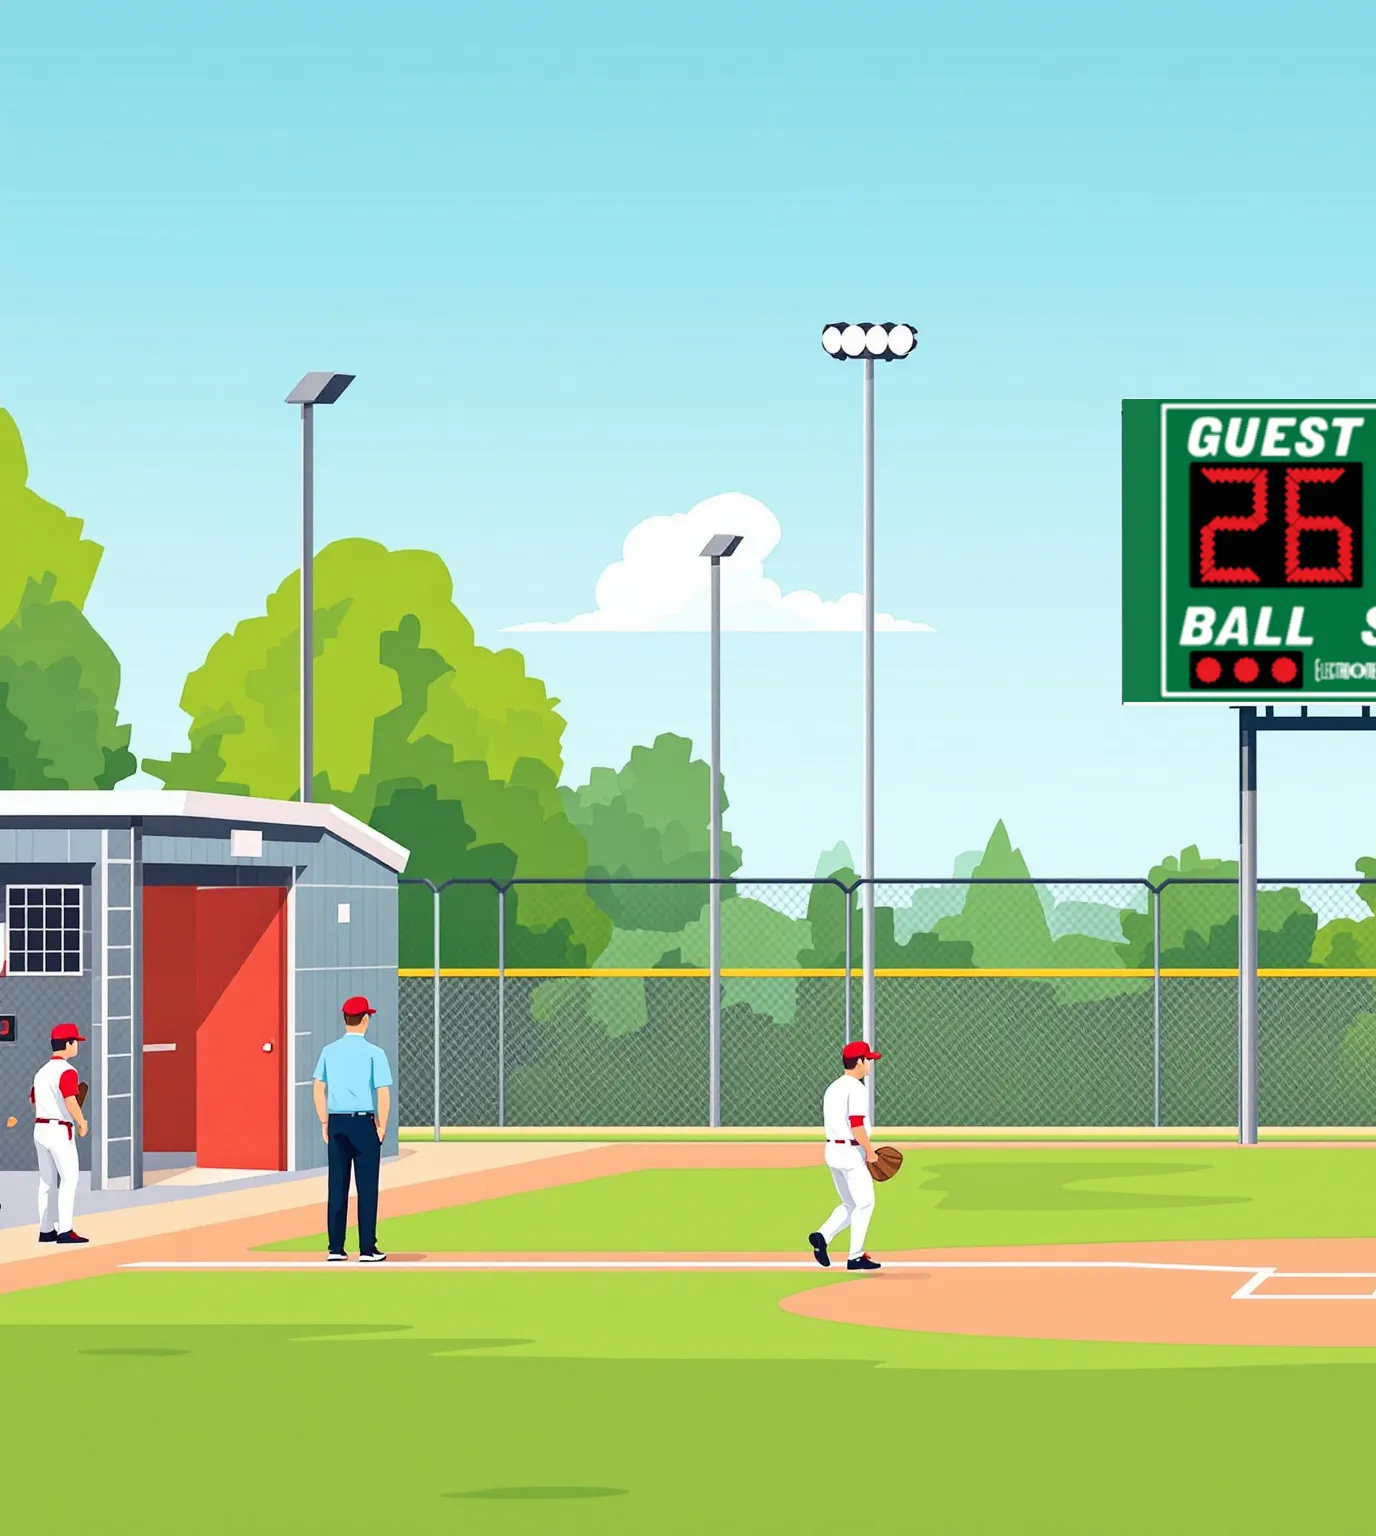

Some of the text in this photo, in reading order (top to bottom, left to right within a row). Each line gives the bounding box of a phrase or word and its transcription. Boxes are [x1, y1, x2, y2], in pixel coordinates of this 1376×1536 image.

[1187, 417, 1364, 457] GUEST
[1201, 467, 1352, 582] 26
[1179, 606, 1314, 646] BALL
